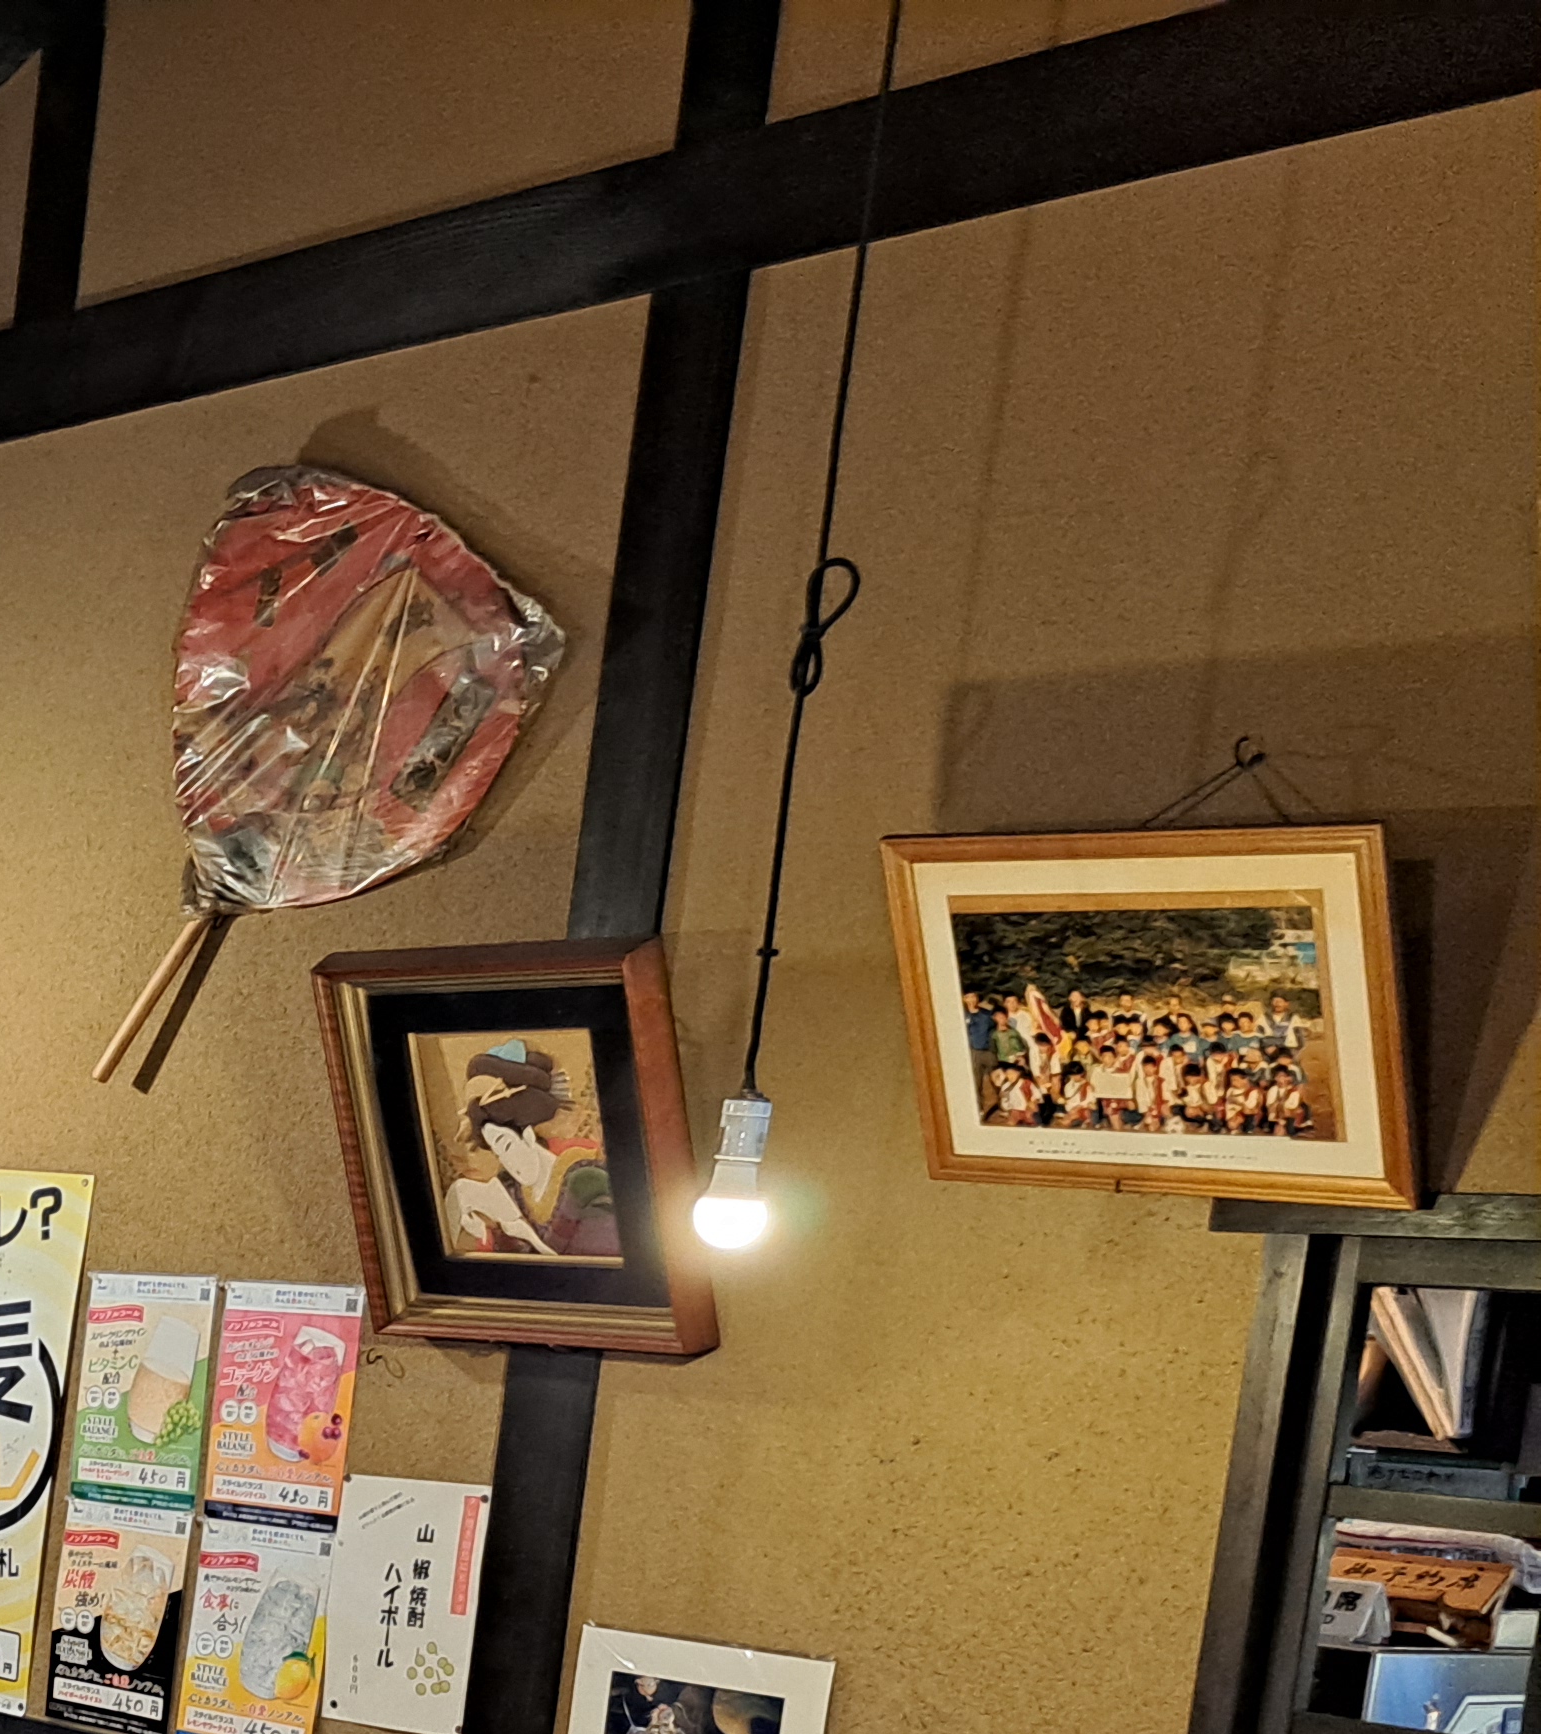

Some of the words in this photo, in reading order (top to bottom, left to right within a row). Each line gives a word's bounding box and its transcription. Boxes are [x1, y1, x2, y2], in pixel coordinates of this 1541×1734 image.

[88, 1355, 139, 1373] ビタミンC
[101, 1371, 121, 1385] 配合
[222, 1431, 251, 1443] STYLE
[217, 1440, 255, 1453] BALANCE
[138, 1467, 168, 1485] 450
[62, 1568, 96, 1590] 炭酸
[74, 1591, 106, 1608] 強め!
[200, 1588, 240, 1612] 食事に
[376, 1562, 403, 1668] ハイボール
[2, 1661, 13, 1675] 円
[195, 1663, 225, 1676] STYLE
[190, 1672, 228, 1687] BALANCE
[112, 1693, 144, 1712] 450
